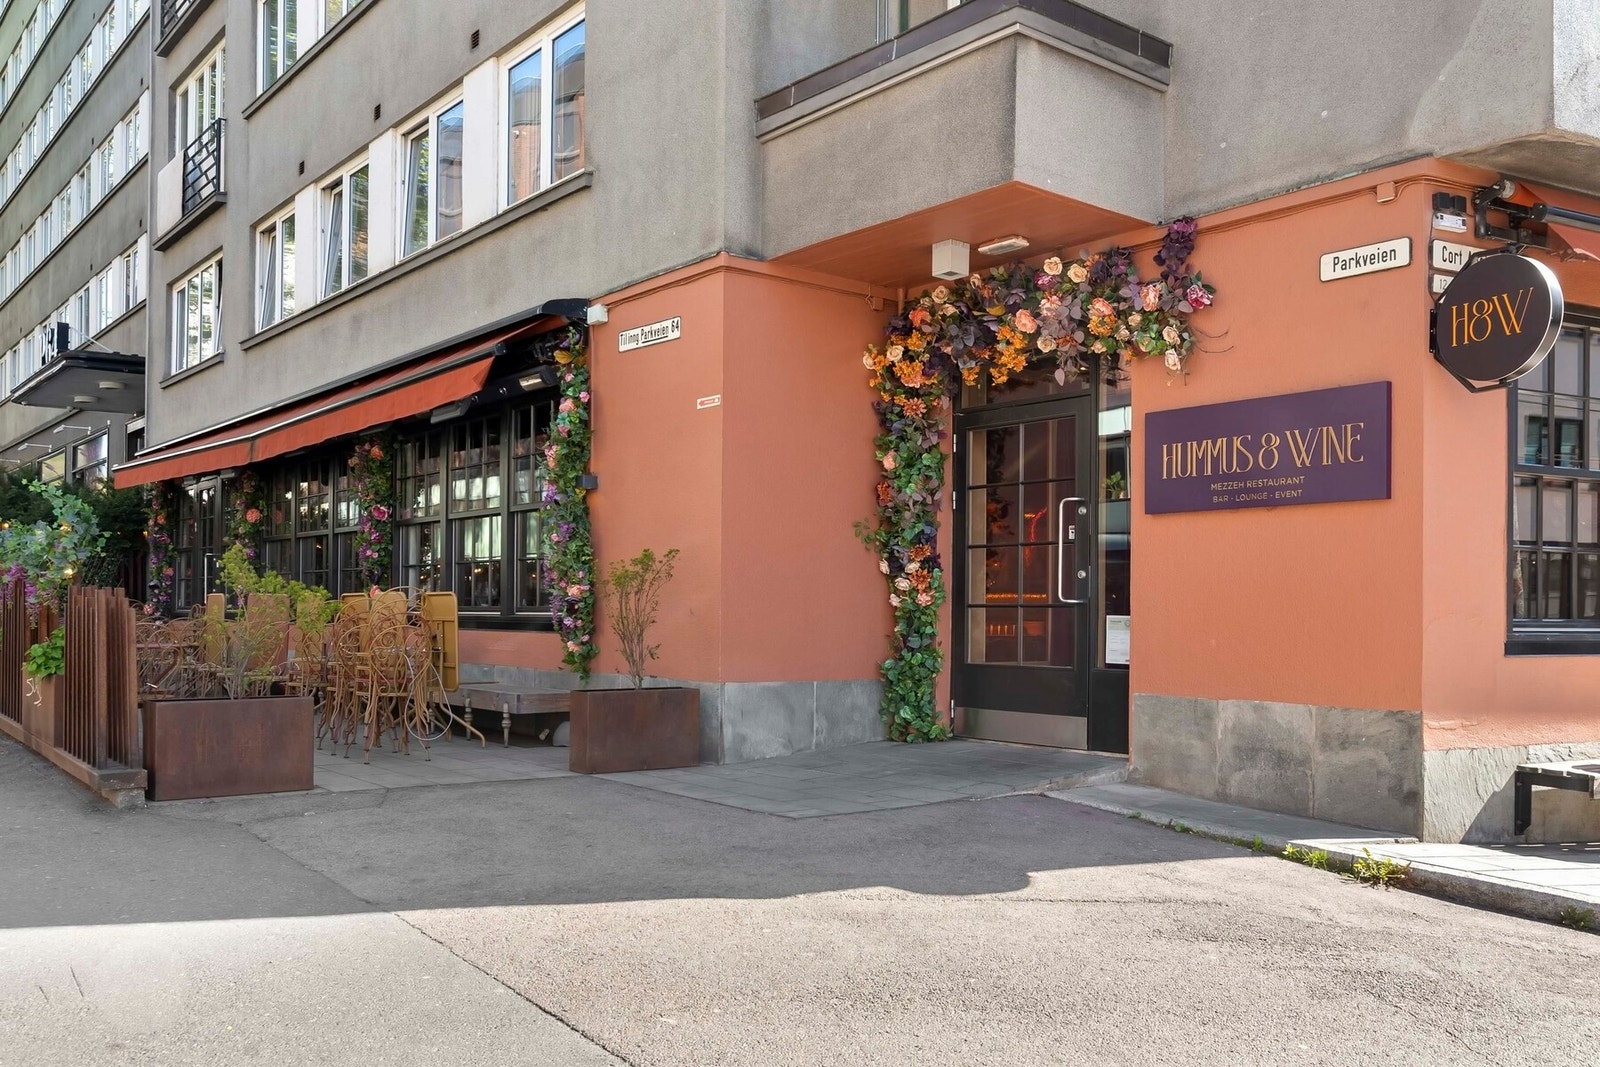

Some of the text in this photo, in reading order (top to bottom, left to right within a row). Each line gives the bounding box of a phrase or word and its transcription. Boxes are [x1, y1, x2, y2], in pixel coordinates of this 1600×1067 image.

[1333, 247, 1397, 272] Parkveien
[1442, 245, 1462, 265] Cort
[641, 324, 669, 340] Parkveien
[671, 319, 679, 333] 64
[1161, 422, 1364, 480] HUMMUS & WINE
[1210, 476, 1305, 491] MEZZEH RESTAURANT
[1212, 495, 1229, 503] BAR
[1235, 492, 1268, 502] LOUNGE
[1275, 489, 1303, 499] EVENT
